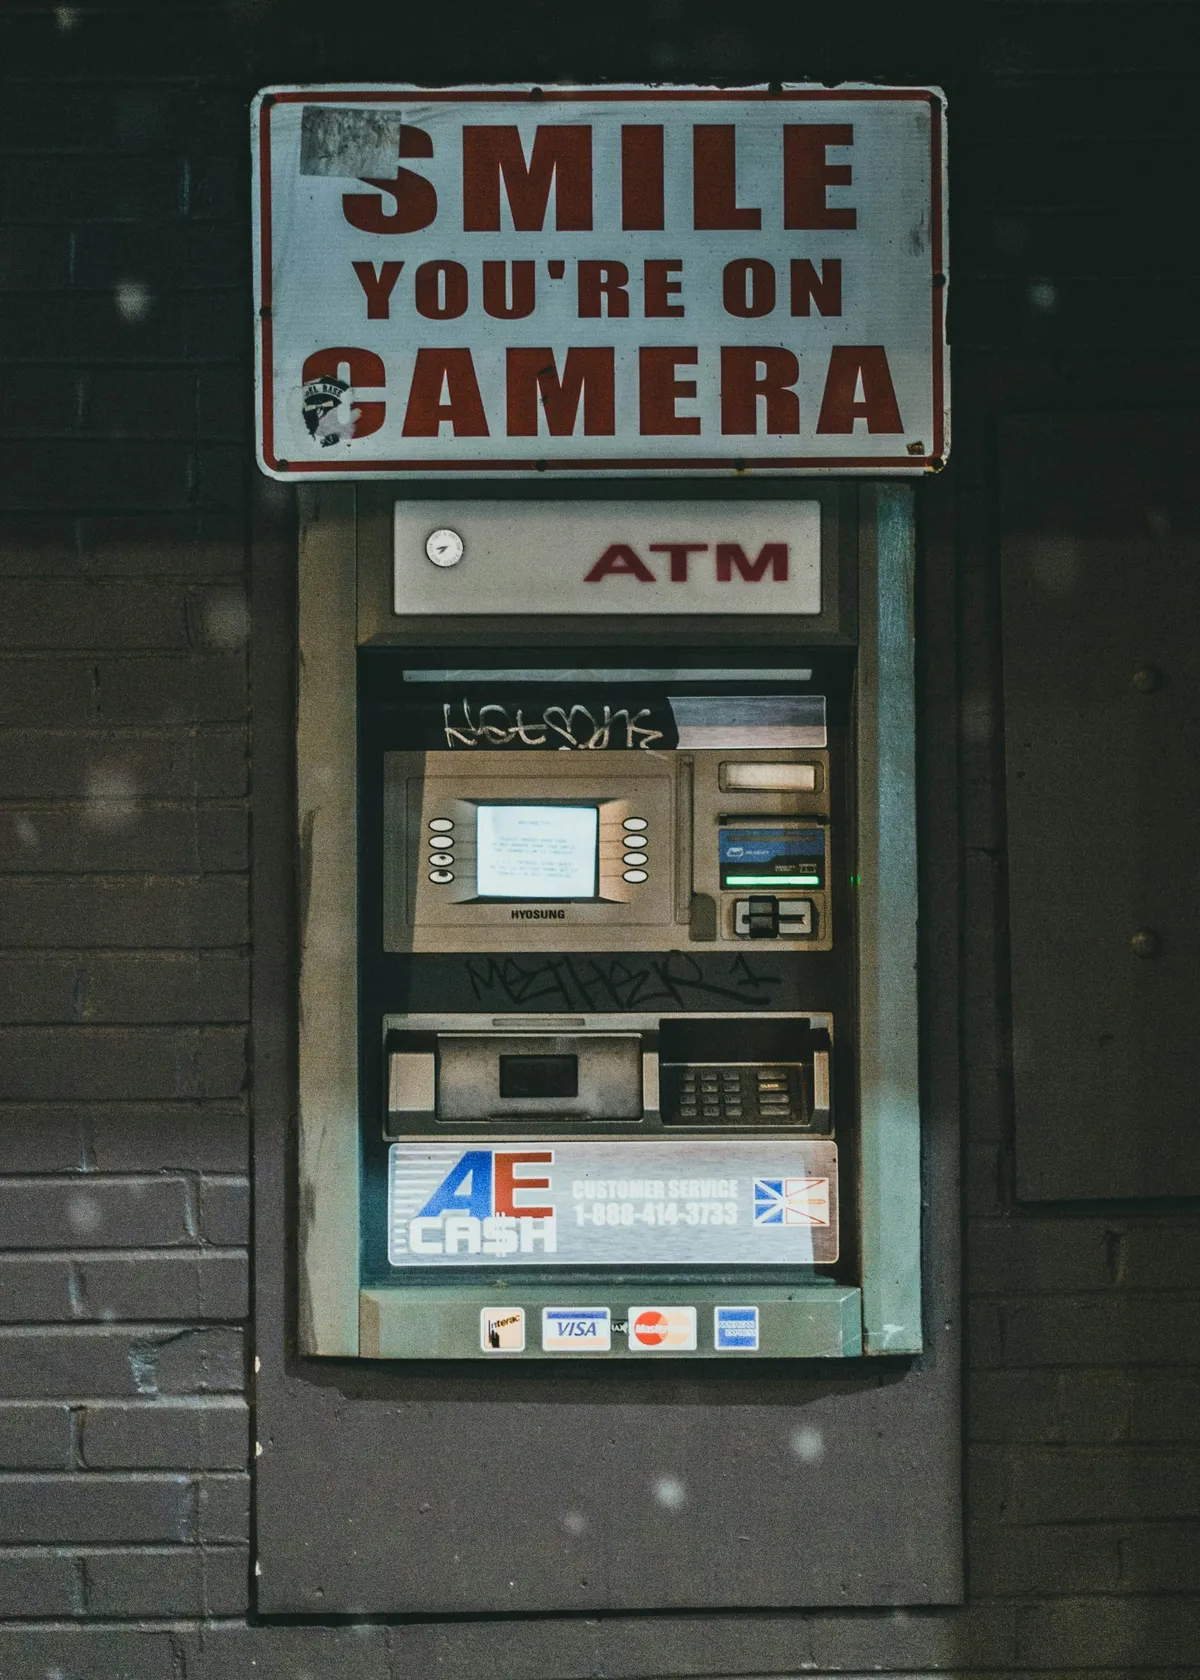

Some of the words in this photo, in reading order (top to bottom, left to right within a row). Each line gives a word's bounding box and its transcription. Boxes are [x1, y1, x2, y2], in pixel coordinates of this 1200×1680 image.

[342, 123, 857, 235] SMILE
[351, 259, 685, 319] YOU'RE
[722, 258, 842, 317] ON
[302, 346, 905, 438] CAMERA
[583, 543, 789, 583] ATM
[511, 909, 565, 920] HYOSUNG
[415, 1150, 555, 1218] AE
[571, 1179, 665, 1199] CUSTOMER
[667, 1179, 739, 1199] SERVICE
[573, 1202, 738, 1226] 1-888-414-3733
[557, 1321, 598, 1337] VISA
